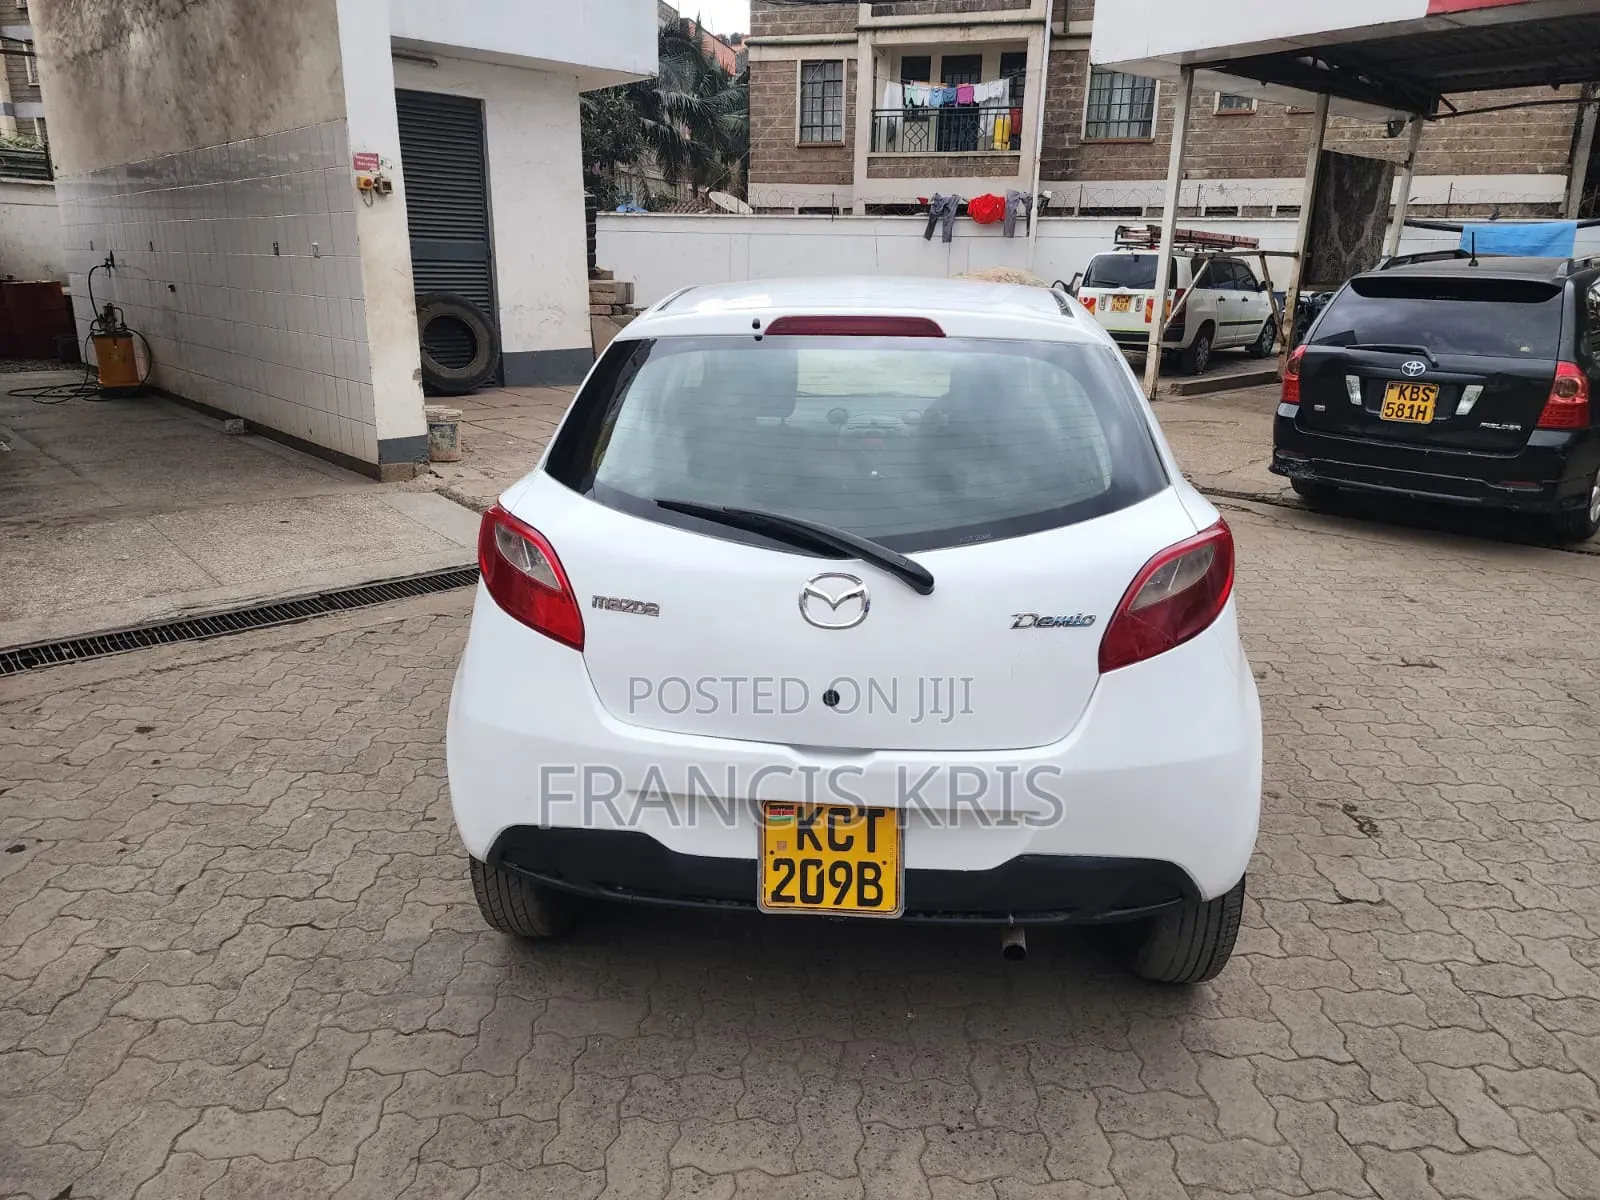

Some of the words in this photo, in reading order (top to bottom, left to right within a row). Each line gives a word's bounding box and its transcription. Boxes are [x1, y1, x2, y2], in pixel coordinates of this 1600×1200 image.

[1398, 385, 1431, 402] KBS
[1384, 402, 1428, 420] 581H
[1009, 612, 1096, 629] Demio
[797, 806, 885, 853] KCT
[771, 858, 884, 907] 209B
